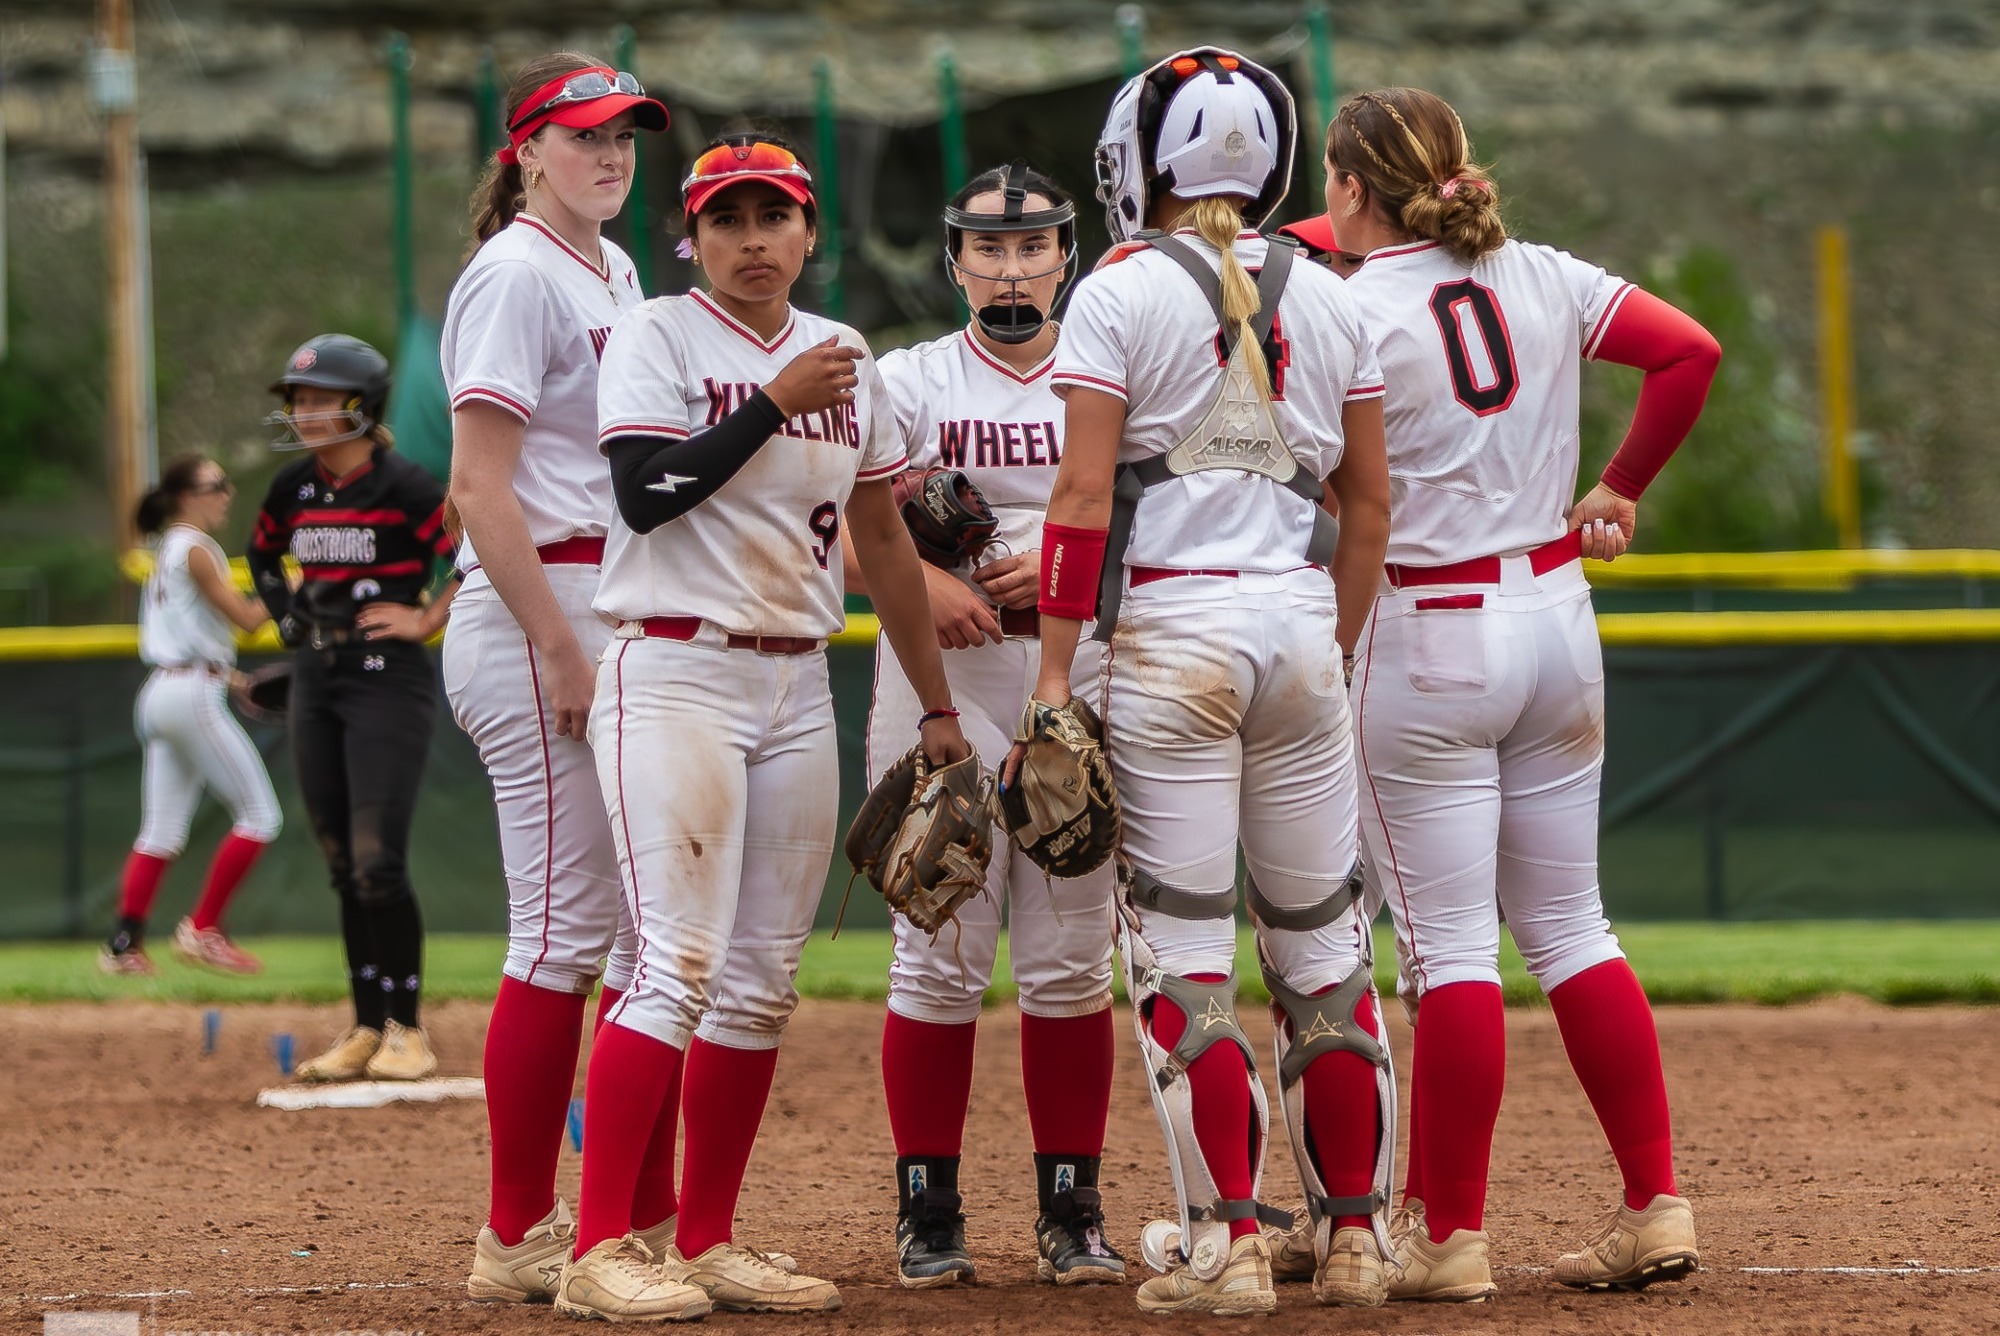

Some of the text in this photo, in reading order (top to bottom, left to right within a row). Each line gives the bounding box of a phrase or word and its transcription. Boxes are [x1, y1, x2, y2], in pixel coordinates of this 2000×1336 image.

[1428, 277, 1520, 418] 0
[1206, 436, 1272, 455] ALL-STAR
[807, 499, 840, 571] 9
[1049, 543, 1065, 598] EASTON
[1045, 812, 1092, 857] ALL-STAR
